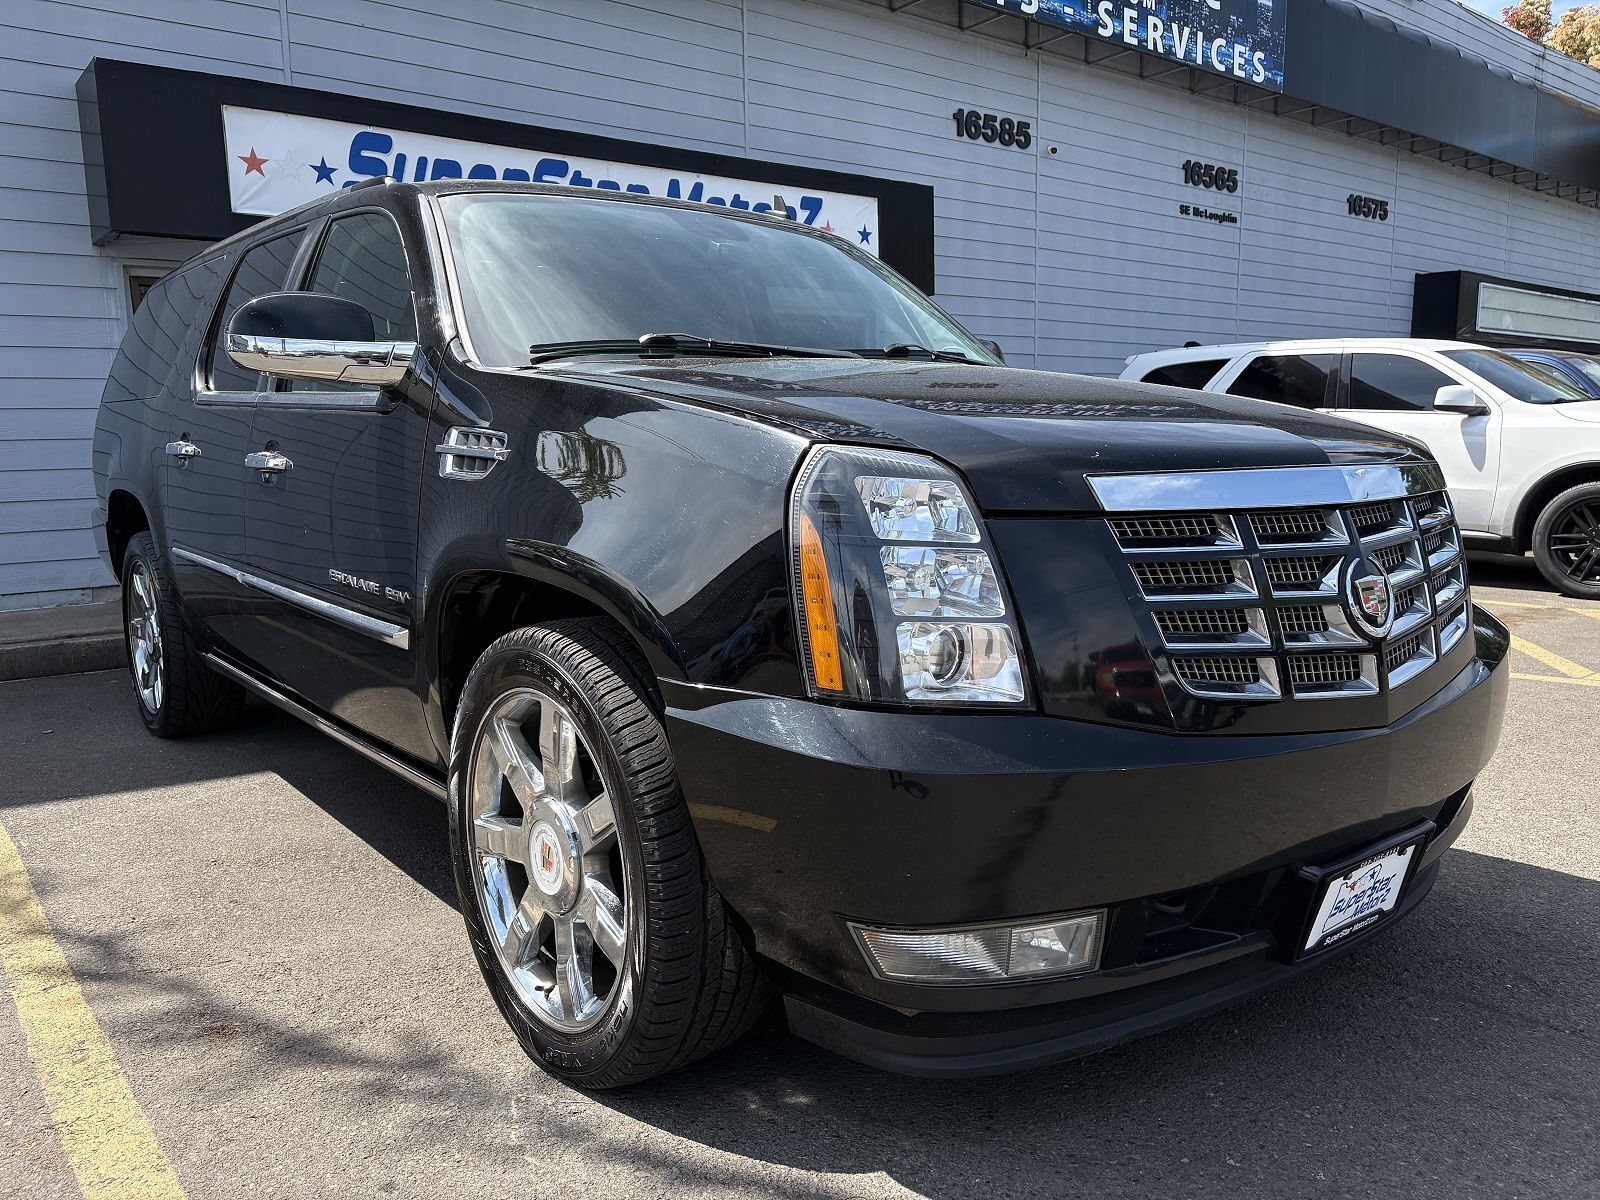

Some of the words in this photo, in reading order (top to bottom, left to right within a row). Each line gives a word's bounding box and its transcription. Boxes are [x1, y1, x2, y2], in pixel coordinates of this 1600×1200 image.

[1097, 1, 1266, 84] SERVICES
[953, 108, 1032, 149] 16585
[1182, 160, 1239, 193] 16565
[1179, 204, 1191, 216] SE
[1192, 206, 1238, 224] McLoughlin
[1346, 193, 1389, 222] 16575
